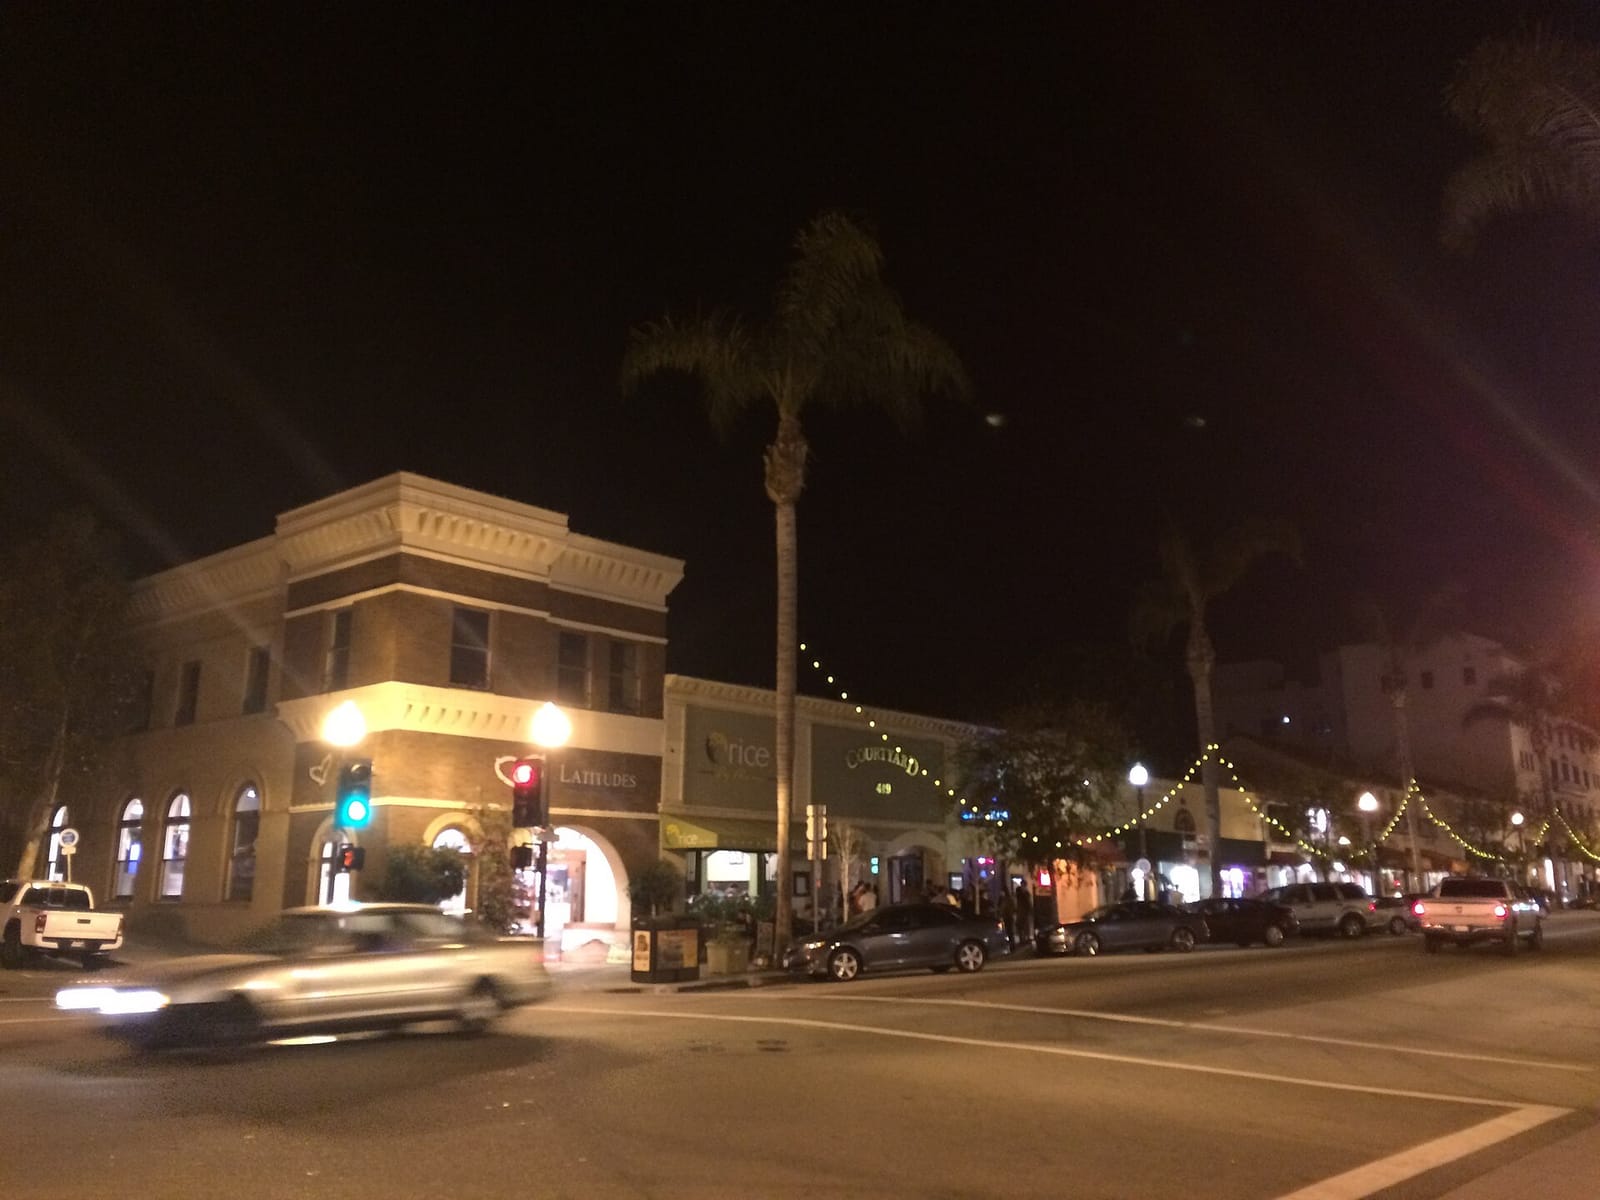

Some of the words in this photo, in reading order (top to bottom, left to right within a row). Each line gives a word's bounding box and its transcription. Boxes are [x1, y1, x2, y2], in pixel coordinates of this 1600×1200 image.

[729, 737, 769, 768] rice
[846, 747, 919, 776] COURTYARD
[560, 763, 637, 788] LATITUDES
